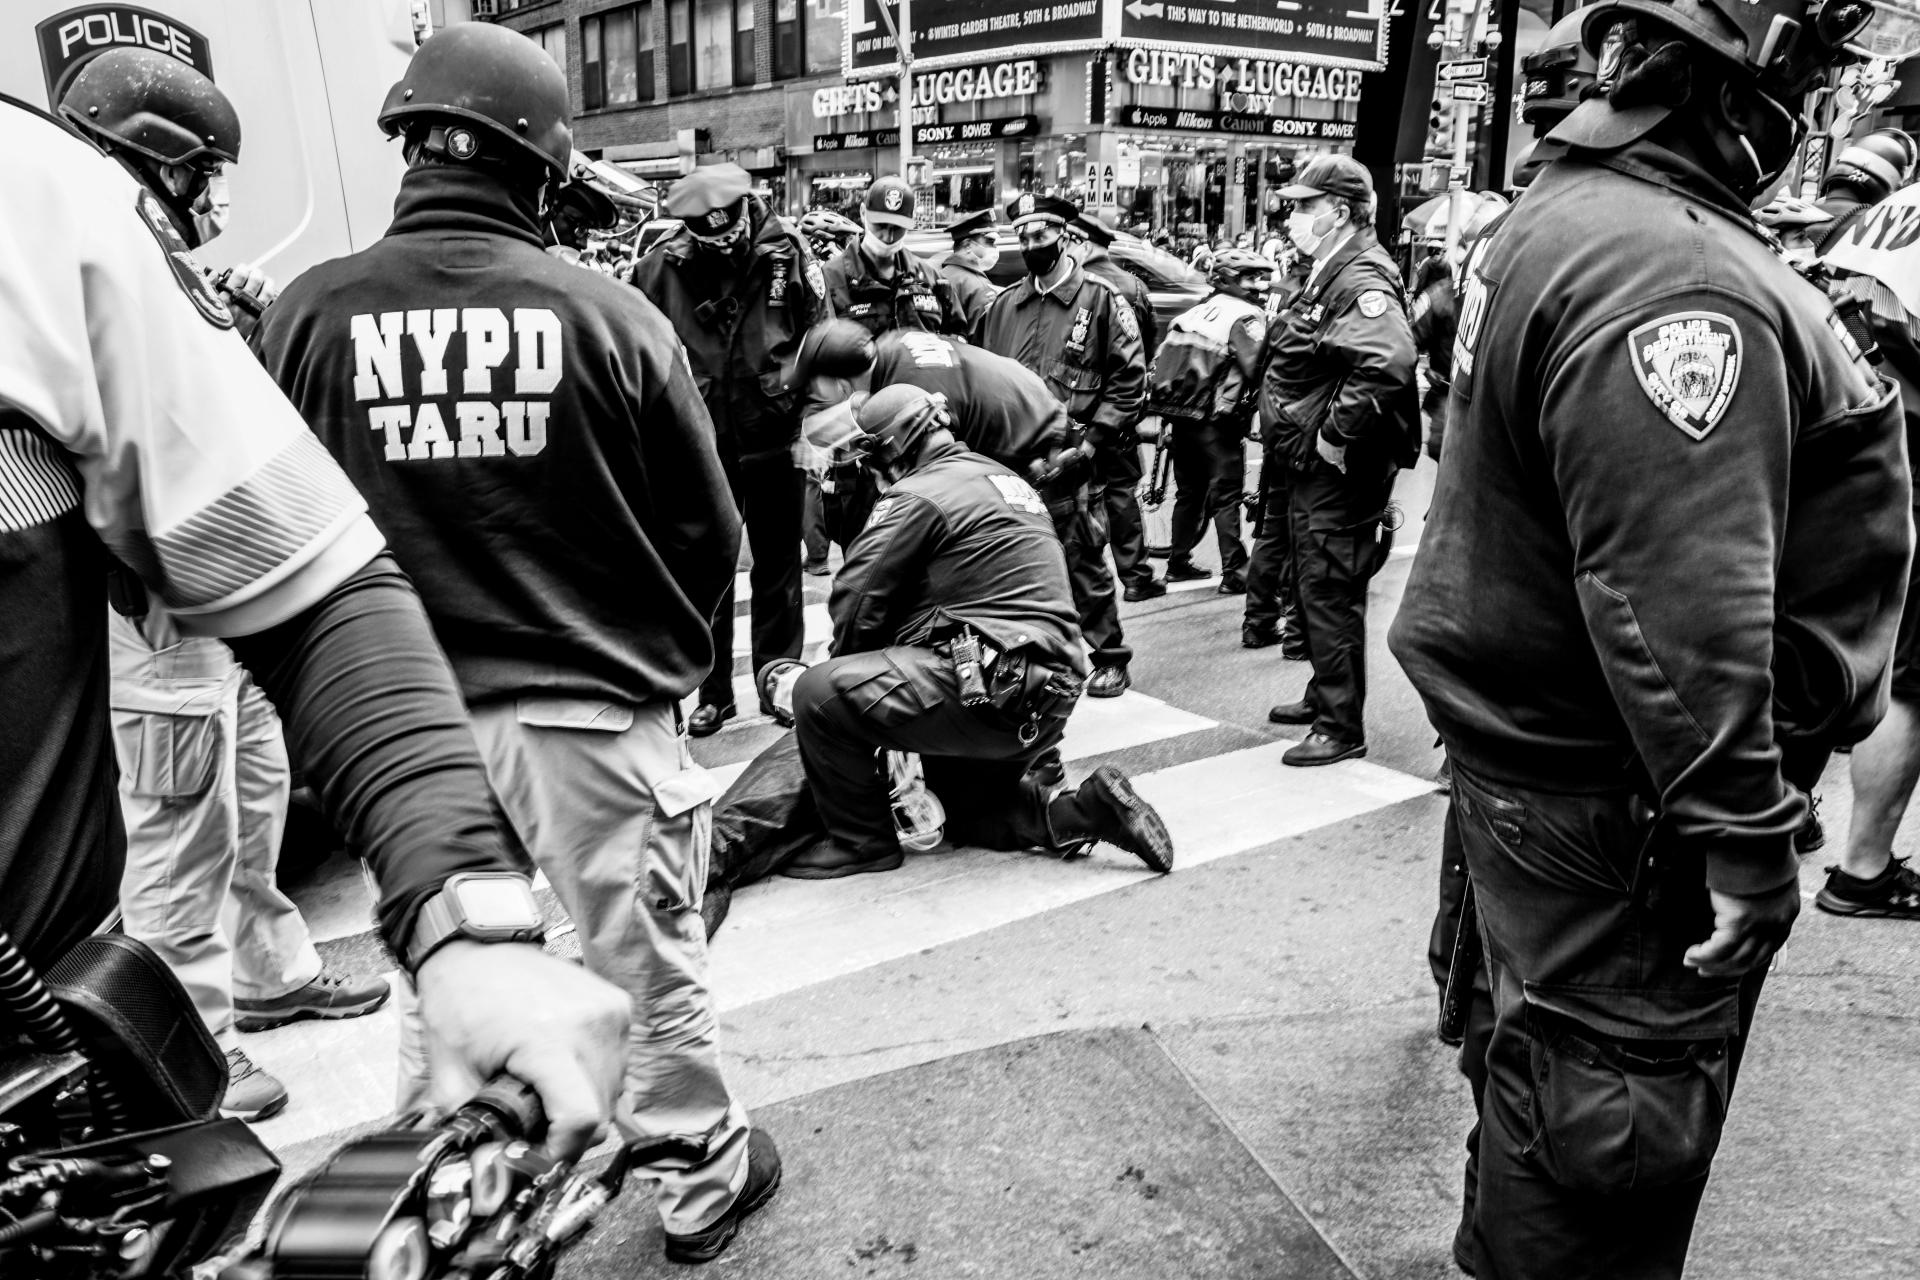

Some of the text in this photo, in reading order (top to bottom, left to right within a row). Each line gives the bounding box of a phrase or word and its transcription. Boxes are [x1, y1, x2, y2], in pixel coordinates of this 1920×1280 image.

[59, 12, 194, 65] POLICE
[857, 38, 871, 53] NOW
[873, 37, 882, 50] ON
[935, 24, 959, 40] WINTER
[961, 18, 989, 36] GARDEN
[990, 12, 1022, 31] THEATRE,
[1023, 8, 1043, 26] 50TH
[1044, 8, 1051, 22] &
[1052, 0, 1098, 20] BROADWAY
[1167, 5, 1374, 43] THIS WAY TO THE NETHERWORLD 50TH & BROADWAY
[813, 60, 1038, 117] GIFTS UGGAGE
[1127, 48, 1363, 102] GIFTS LUGGAGE
[1445, 66, 1479, 75] ONE WAY
[1222, 92, 1276, 116] I NY
[823, 139, 838, 149] Apple
[844, 134, 868, 148] Nikon
[917, 126, 955, 143] SONY
[962, 123, 992, 138] BOWER
[1142, 112, 1355, 137] Apple Nikon Canon SONY BOWER
[1087, 165, 1097, 203] ATM
[1103, 165, 1114, 203] ATM
[1658, 320, 1711, 339] POLICE
[351, 308, 563, 401] NYPD
[368, 401, 550, 461] TARU
